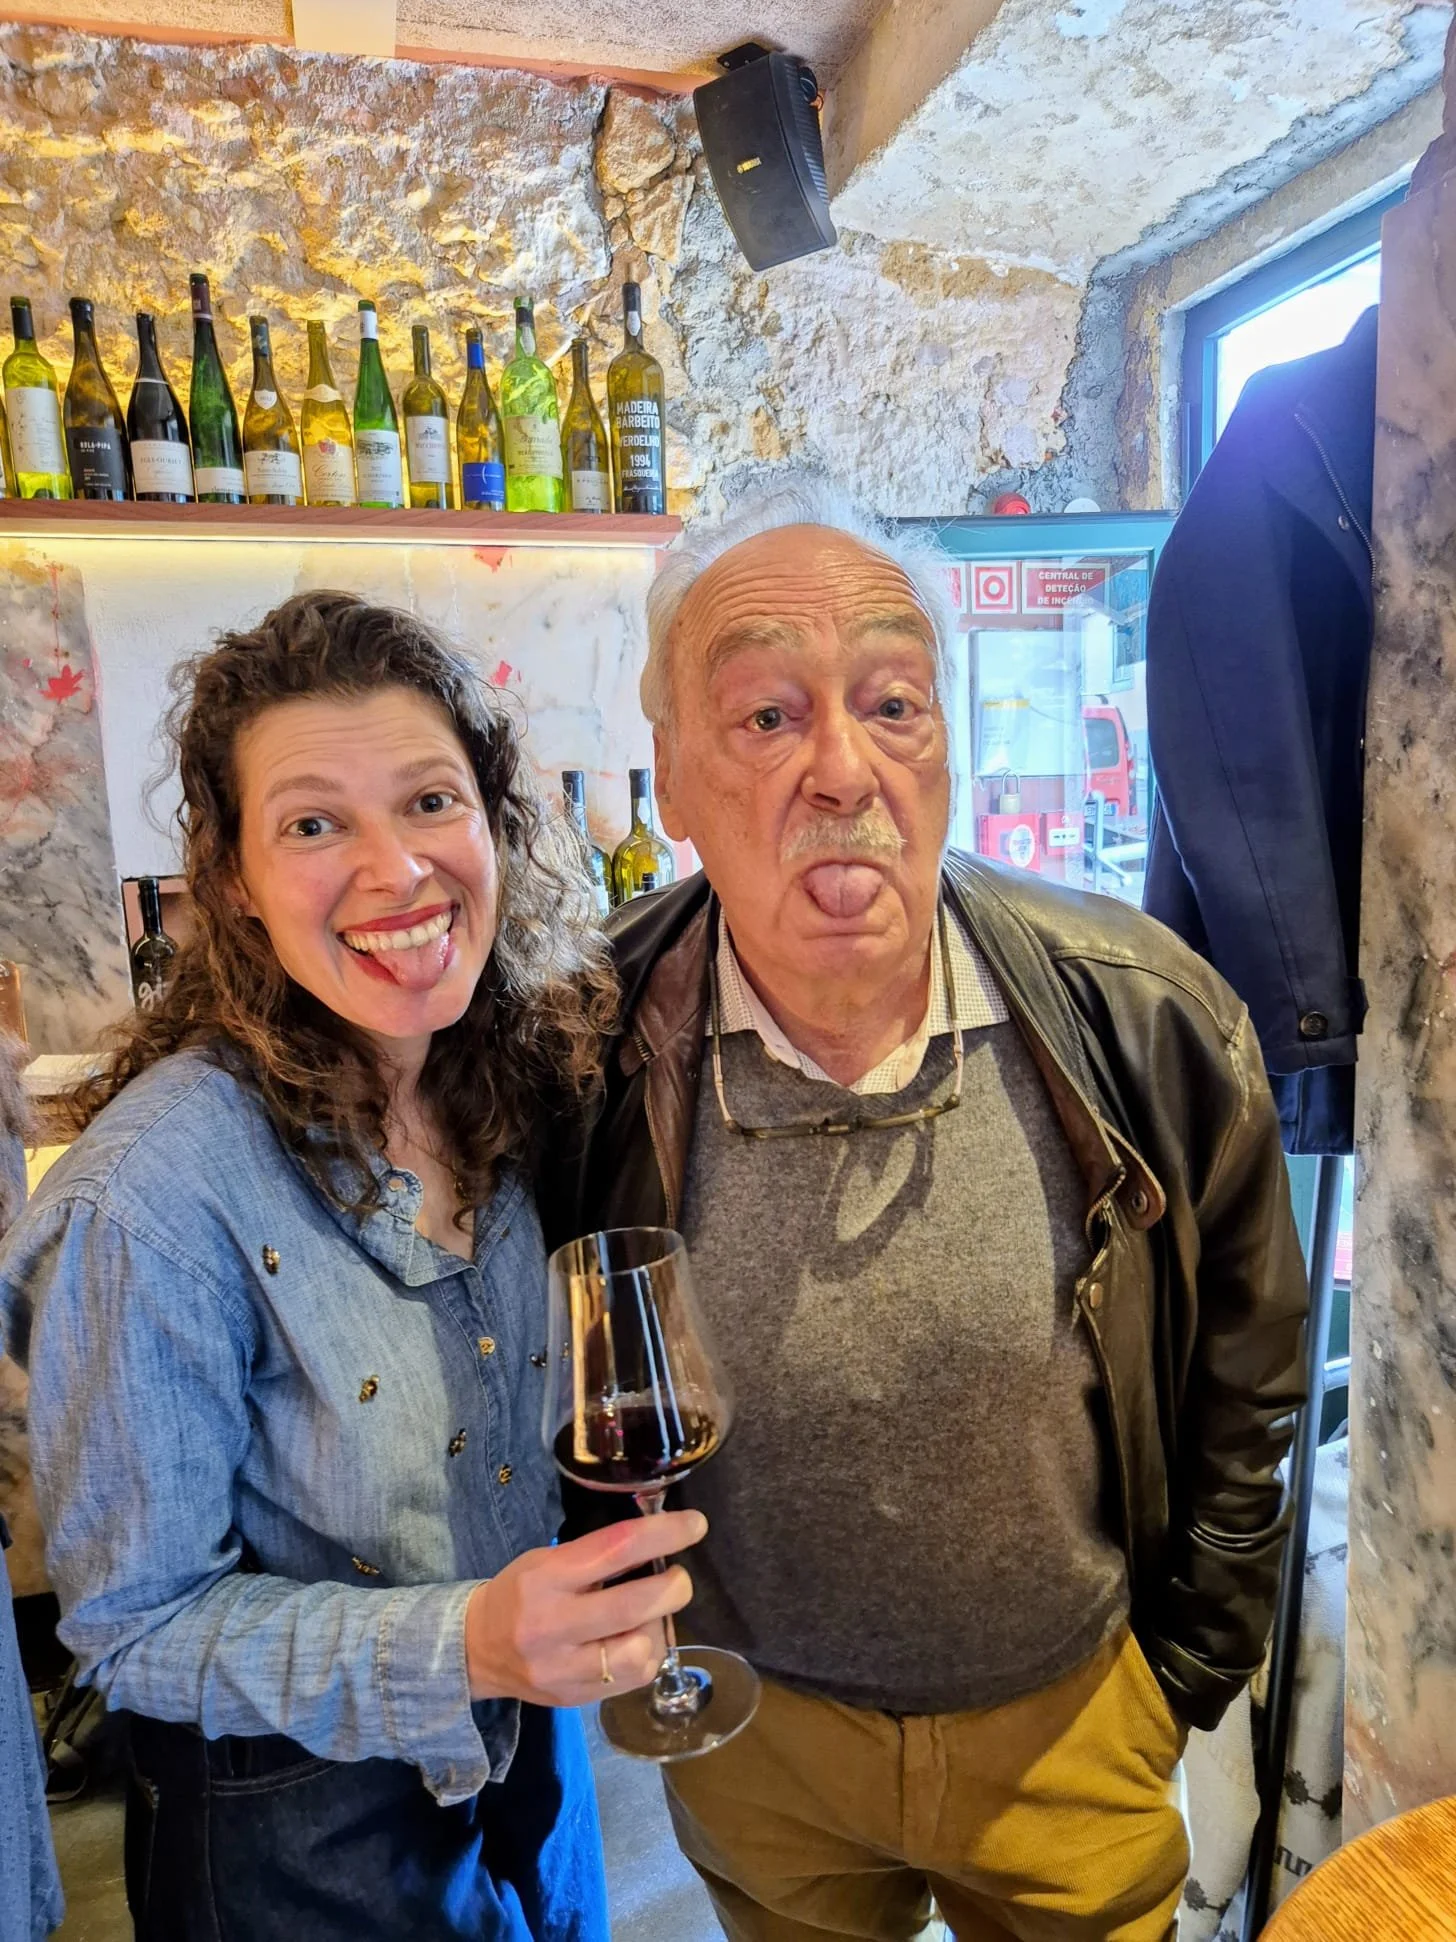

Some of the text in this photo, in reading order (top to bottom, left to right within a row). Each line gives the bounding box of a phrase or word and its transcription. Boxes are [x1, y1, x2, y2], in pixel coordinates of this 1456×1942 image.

[616, 401, 659, 415] MADEIRA
[615, 415, 660, 429] BARBEITO
[619, 434, 660, 447] VERDELHO
[630, 454, 651, 467] 1994
[1038, 571, 1094, 580] CENTRAL DE
[1045, 583, 1087, 594] DETEÇÃO
[1037, 595, 1094, 605] DE INCÊNO
